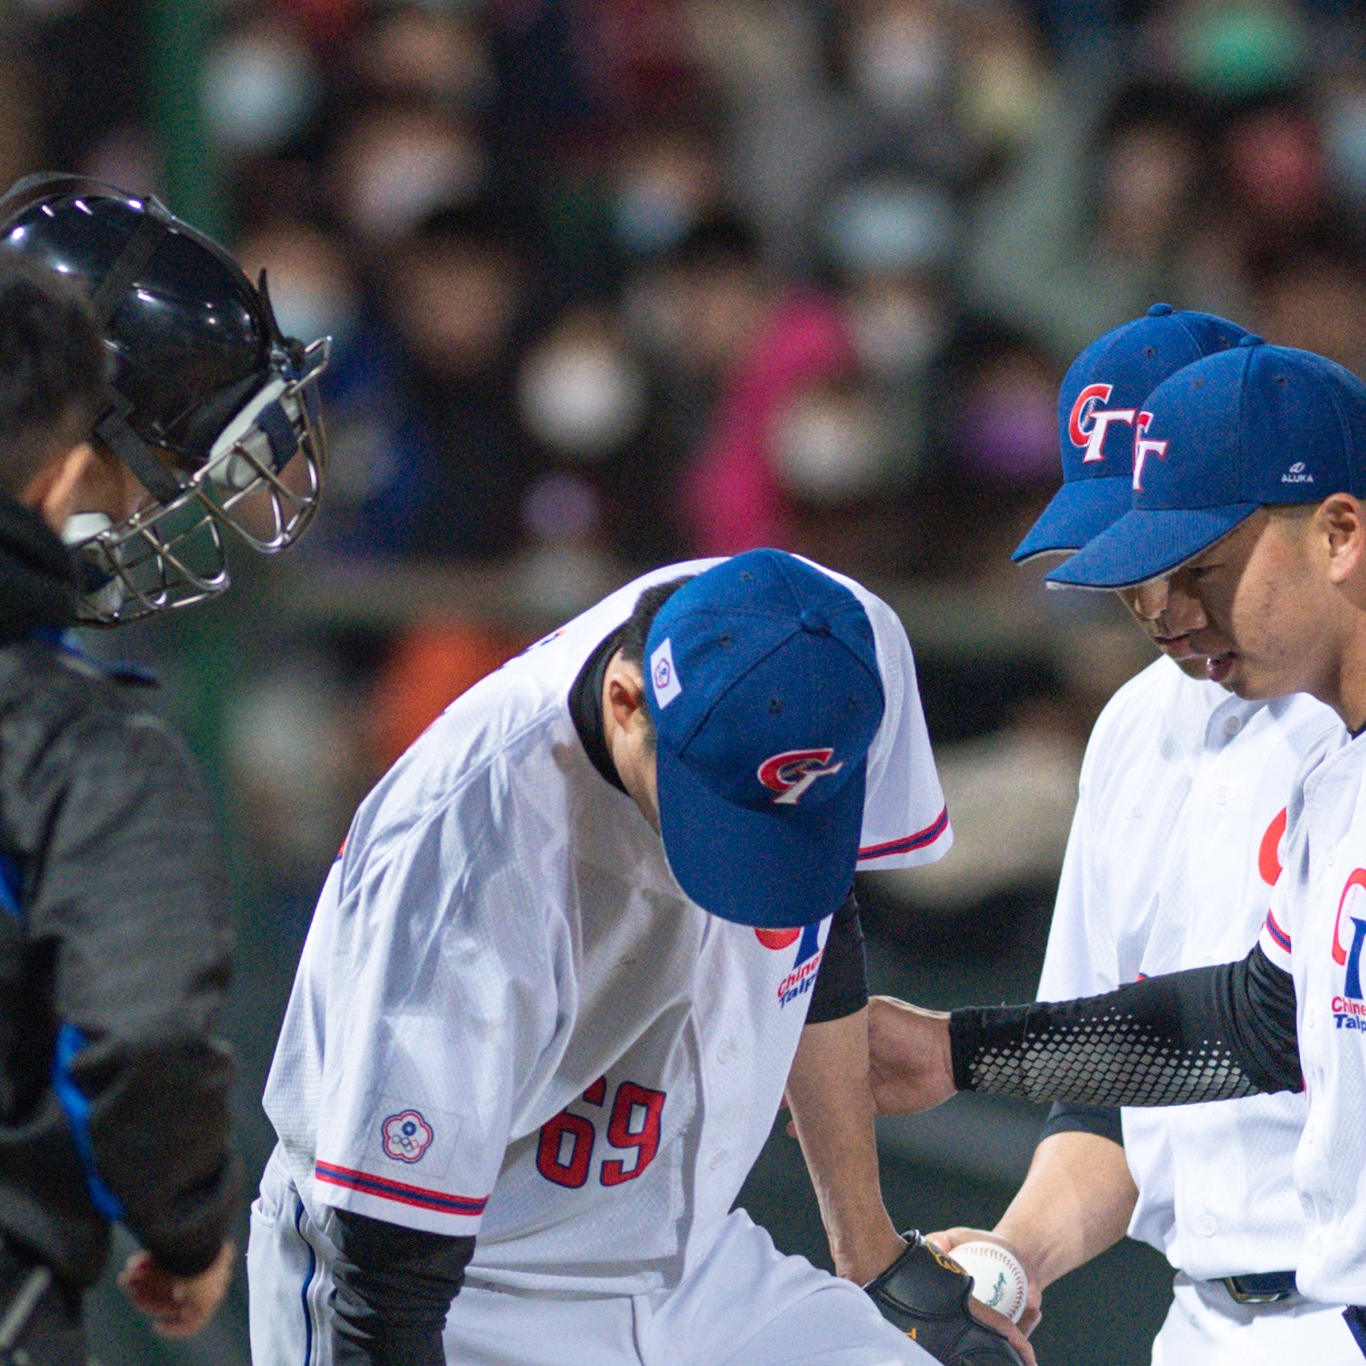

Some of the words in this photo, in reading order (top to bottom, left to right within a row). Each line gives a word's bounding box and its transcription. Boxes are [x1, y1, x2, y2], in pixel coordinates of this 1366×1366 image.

[1281, 473, 1314, 483] ALUKA
[777, 952, 822, 998] Chine
[779, 972, 816, 1009] Taip
[536, 1074, 667, 1189] 69
